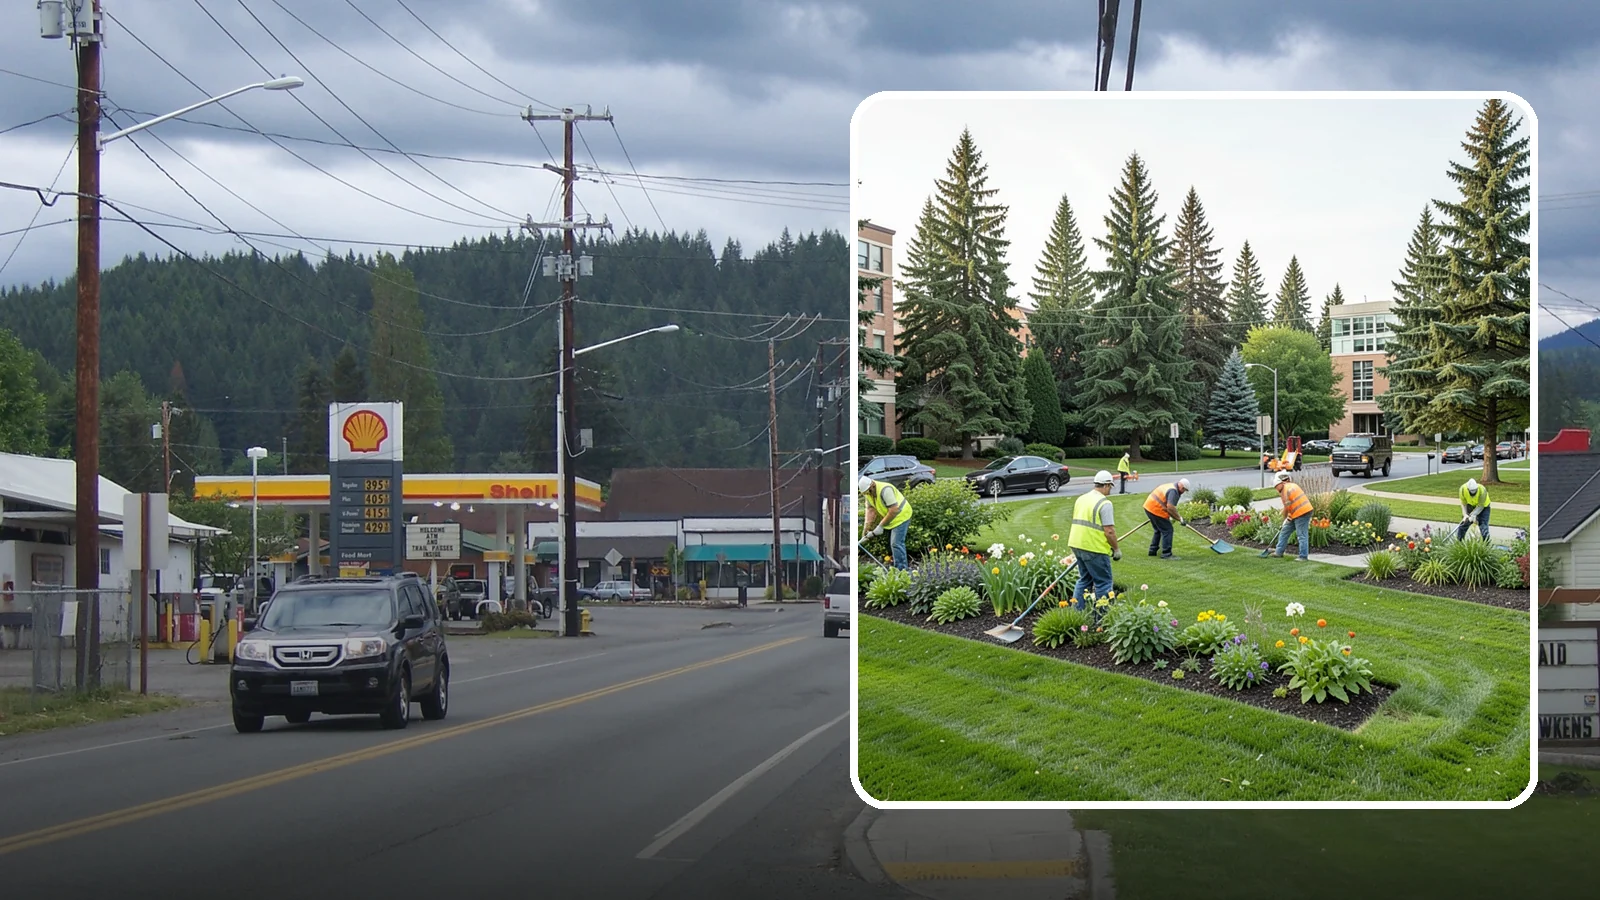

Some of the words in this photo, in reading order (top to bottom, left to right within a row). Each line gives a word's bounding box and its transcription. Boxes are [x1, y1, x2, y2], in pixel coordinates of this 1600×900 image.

[366, 480, 383, 491] 395
[490, 484, 547, 499] Shell
[365, 494, 383, 504] 405
[365, 508, 383, 518] 415
[366, 522, 383, 533] 429
[1539, 643, 1567, 665] AID
